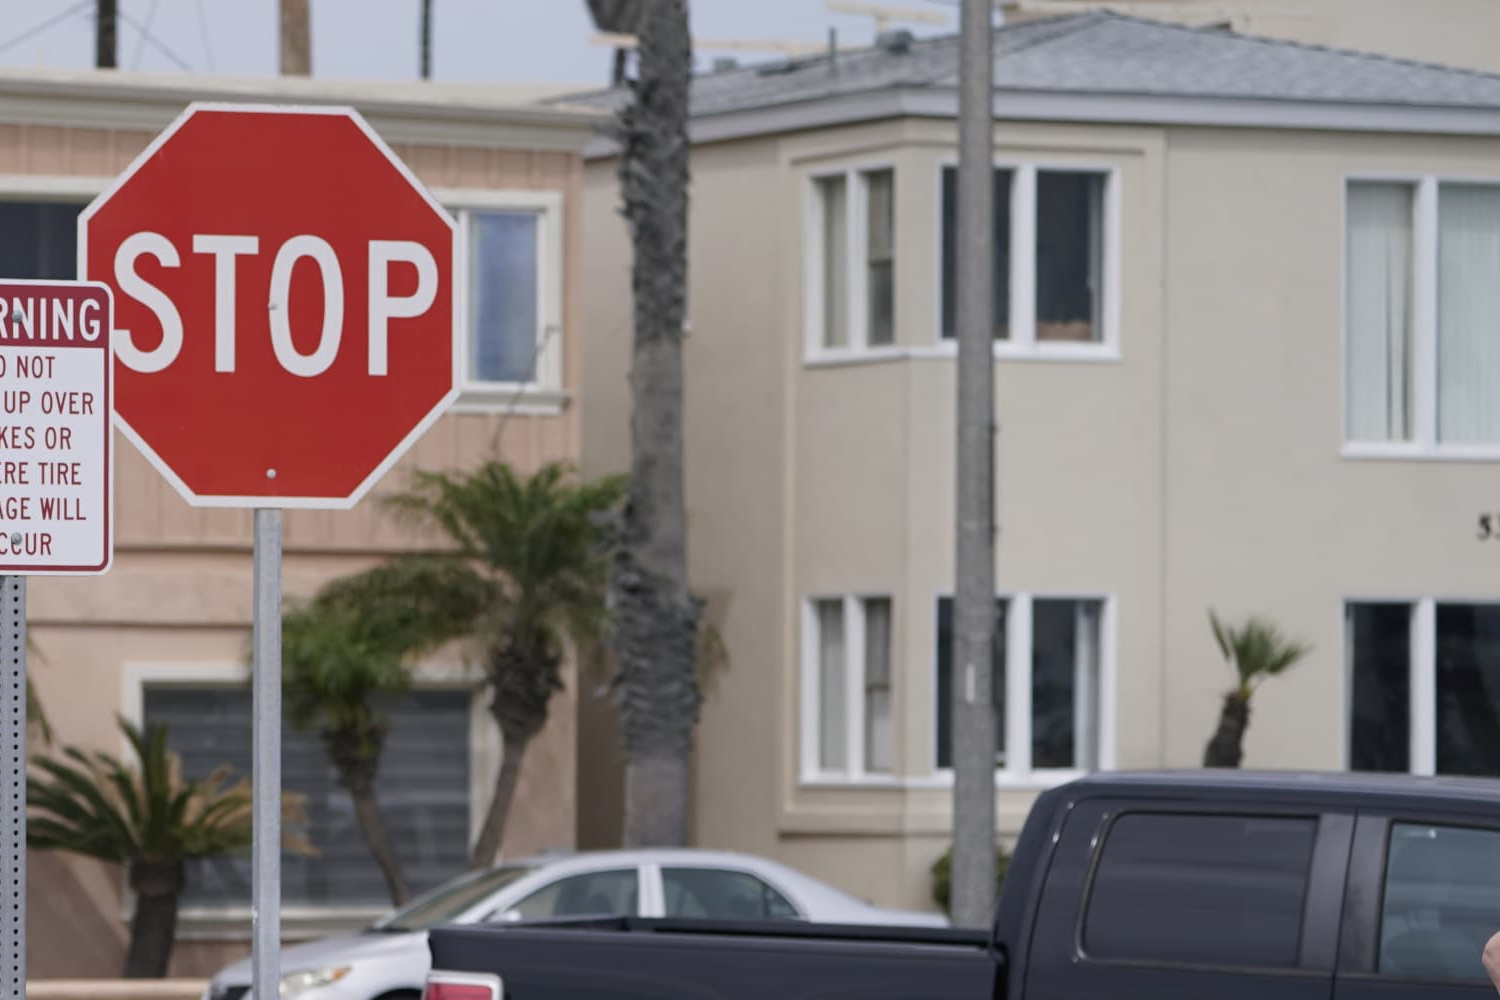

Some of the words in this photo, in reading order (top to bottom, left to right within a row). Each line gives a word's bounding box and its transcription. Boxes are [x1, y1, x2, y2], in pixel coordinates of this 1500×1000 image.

[113, 231, 439, 377] STOP
[16, 355, 56, 379] NOT
[4, 390, 32, 414] UP
[41, 391, 94, 415] OVER
[44, 426, 72, 450] OR
[38, 462, 82, 485] TIRE
[40, 497, 87, 520] WILL
[1475, 511, 1500, 543] 5
